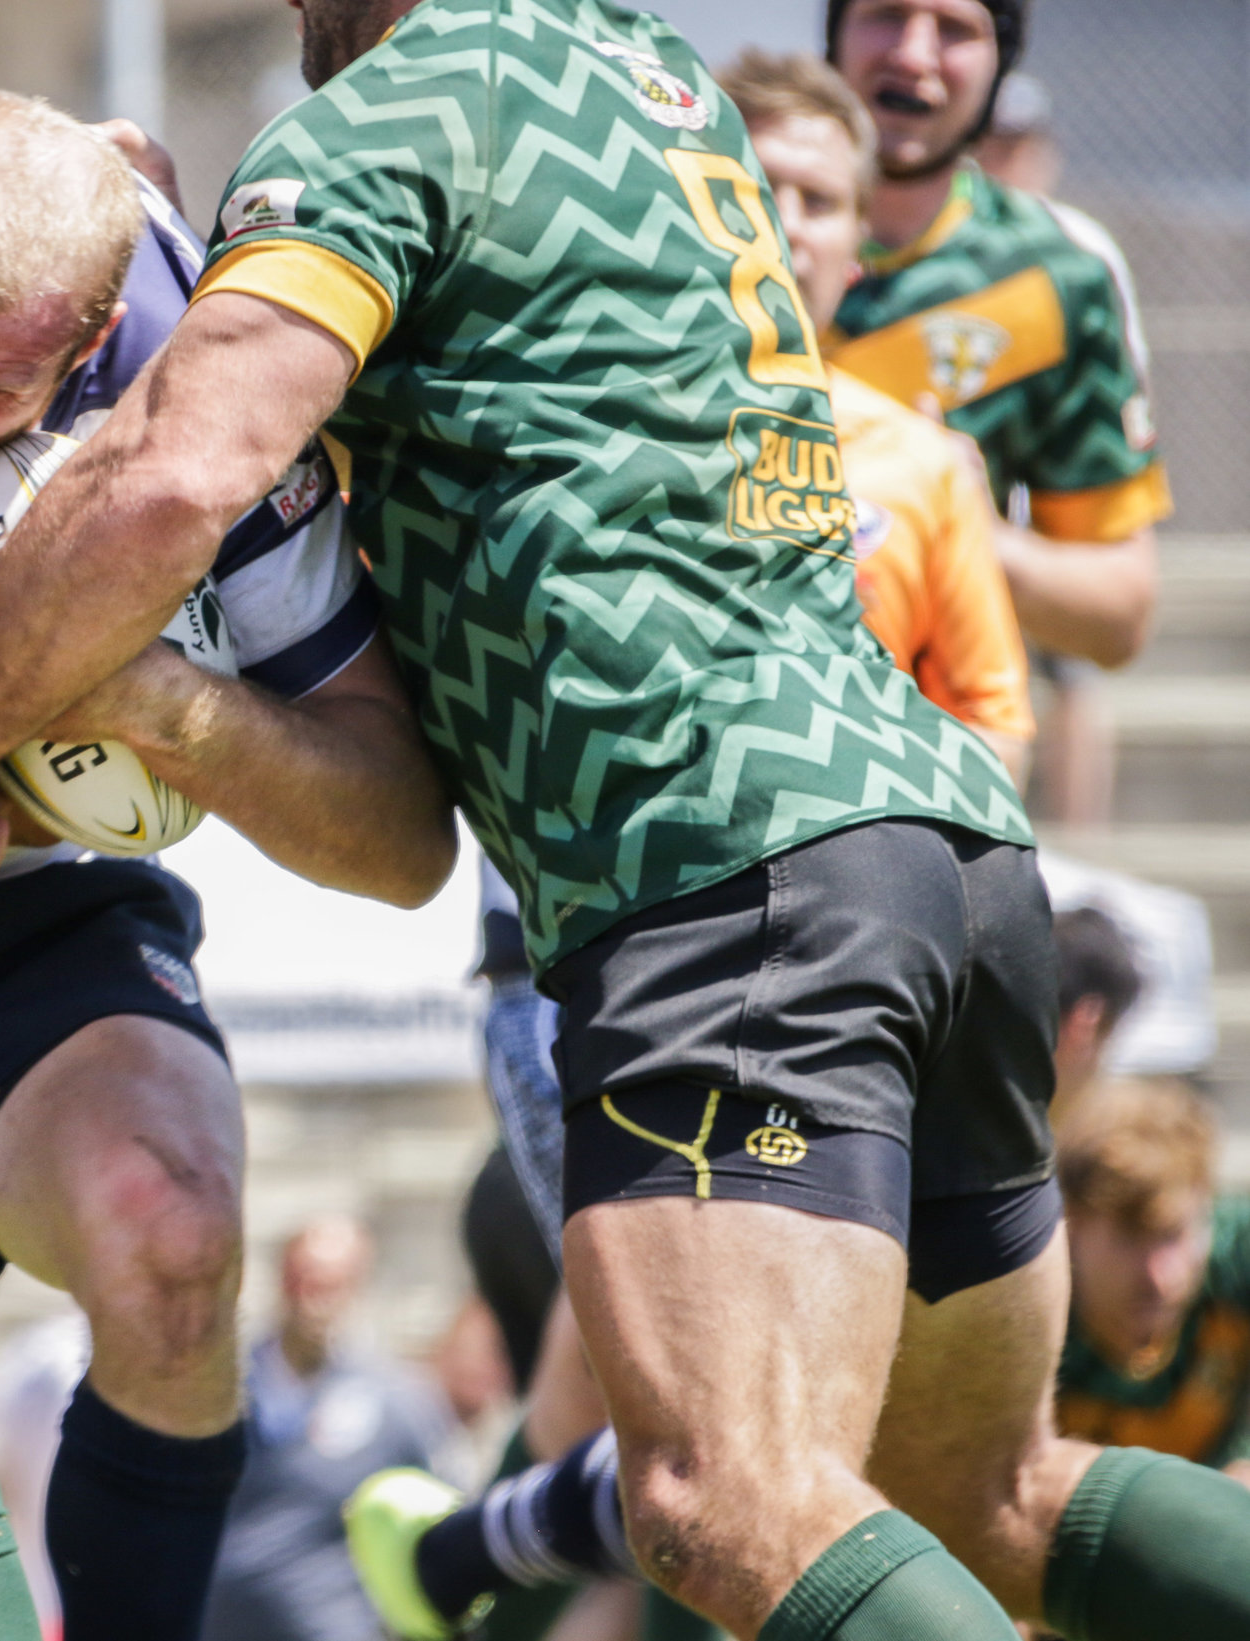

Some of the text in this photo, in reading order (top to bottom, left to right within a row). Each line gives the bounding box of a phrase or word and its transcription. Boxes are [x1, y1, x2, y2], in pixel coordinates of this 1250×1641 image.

[662, 147, 829, 393] 8
[752, 428, 844, 493] BUD
[184, 597, 206, 653] bury
